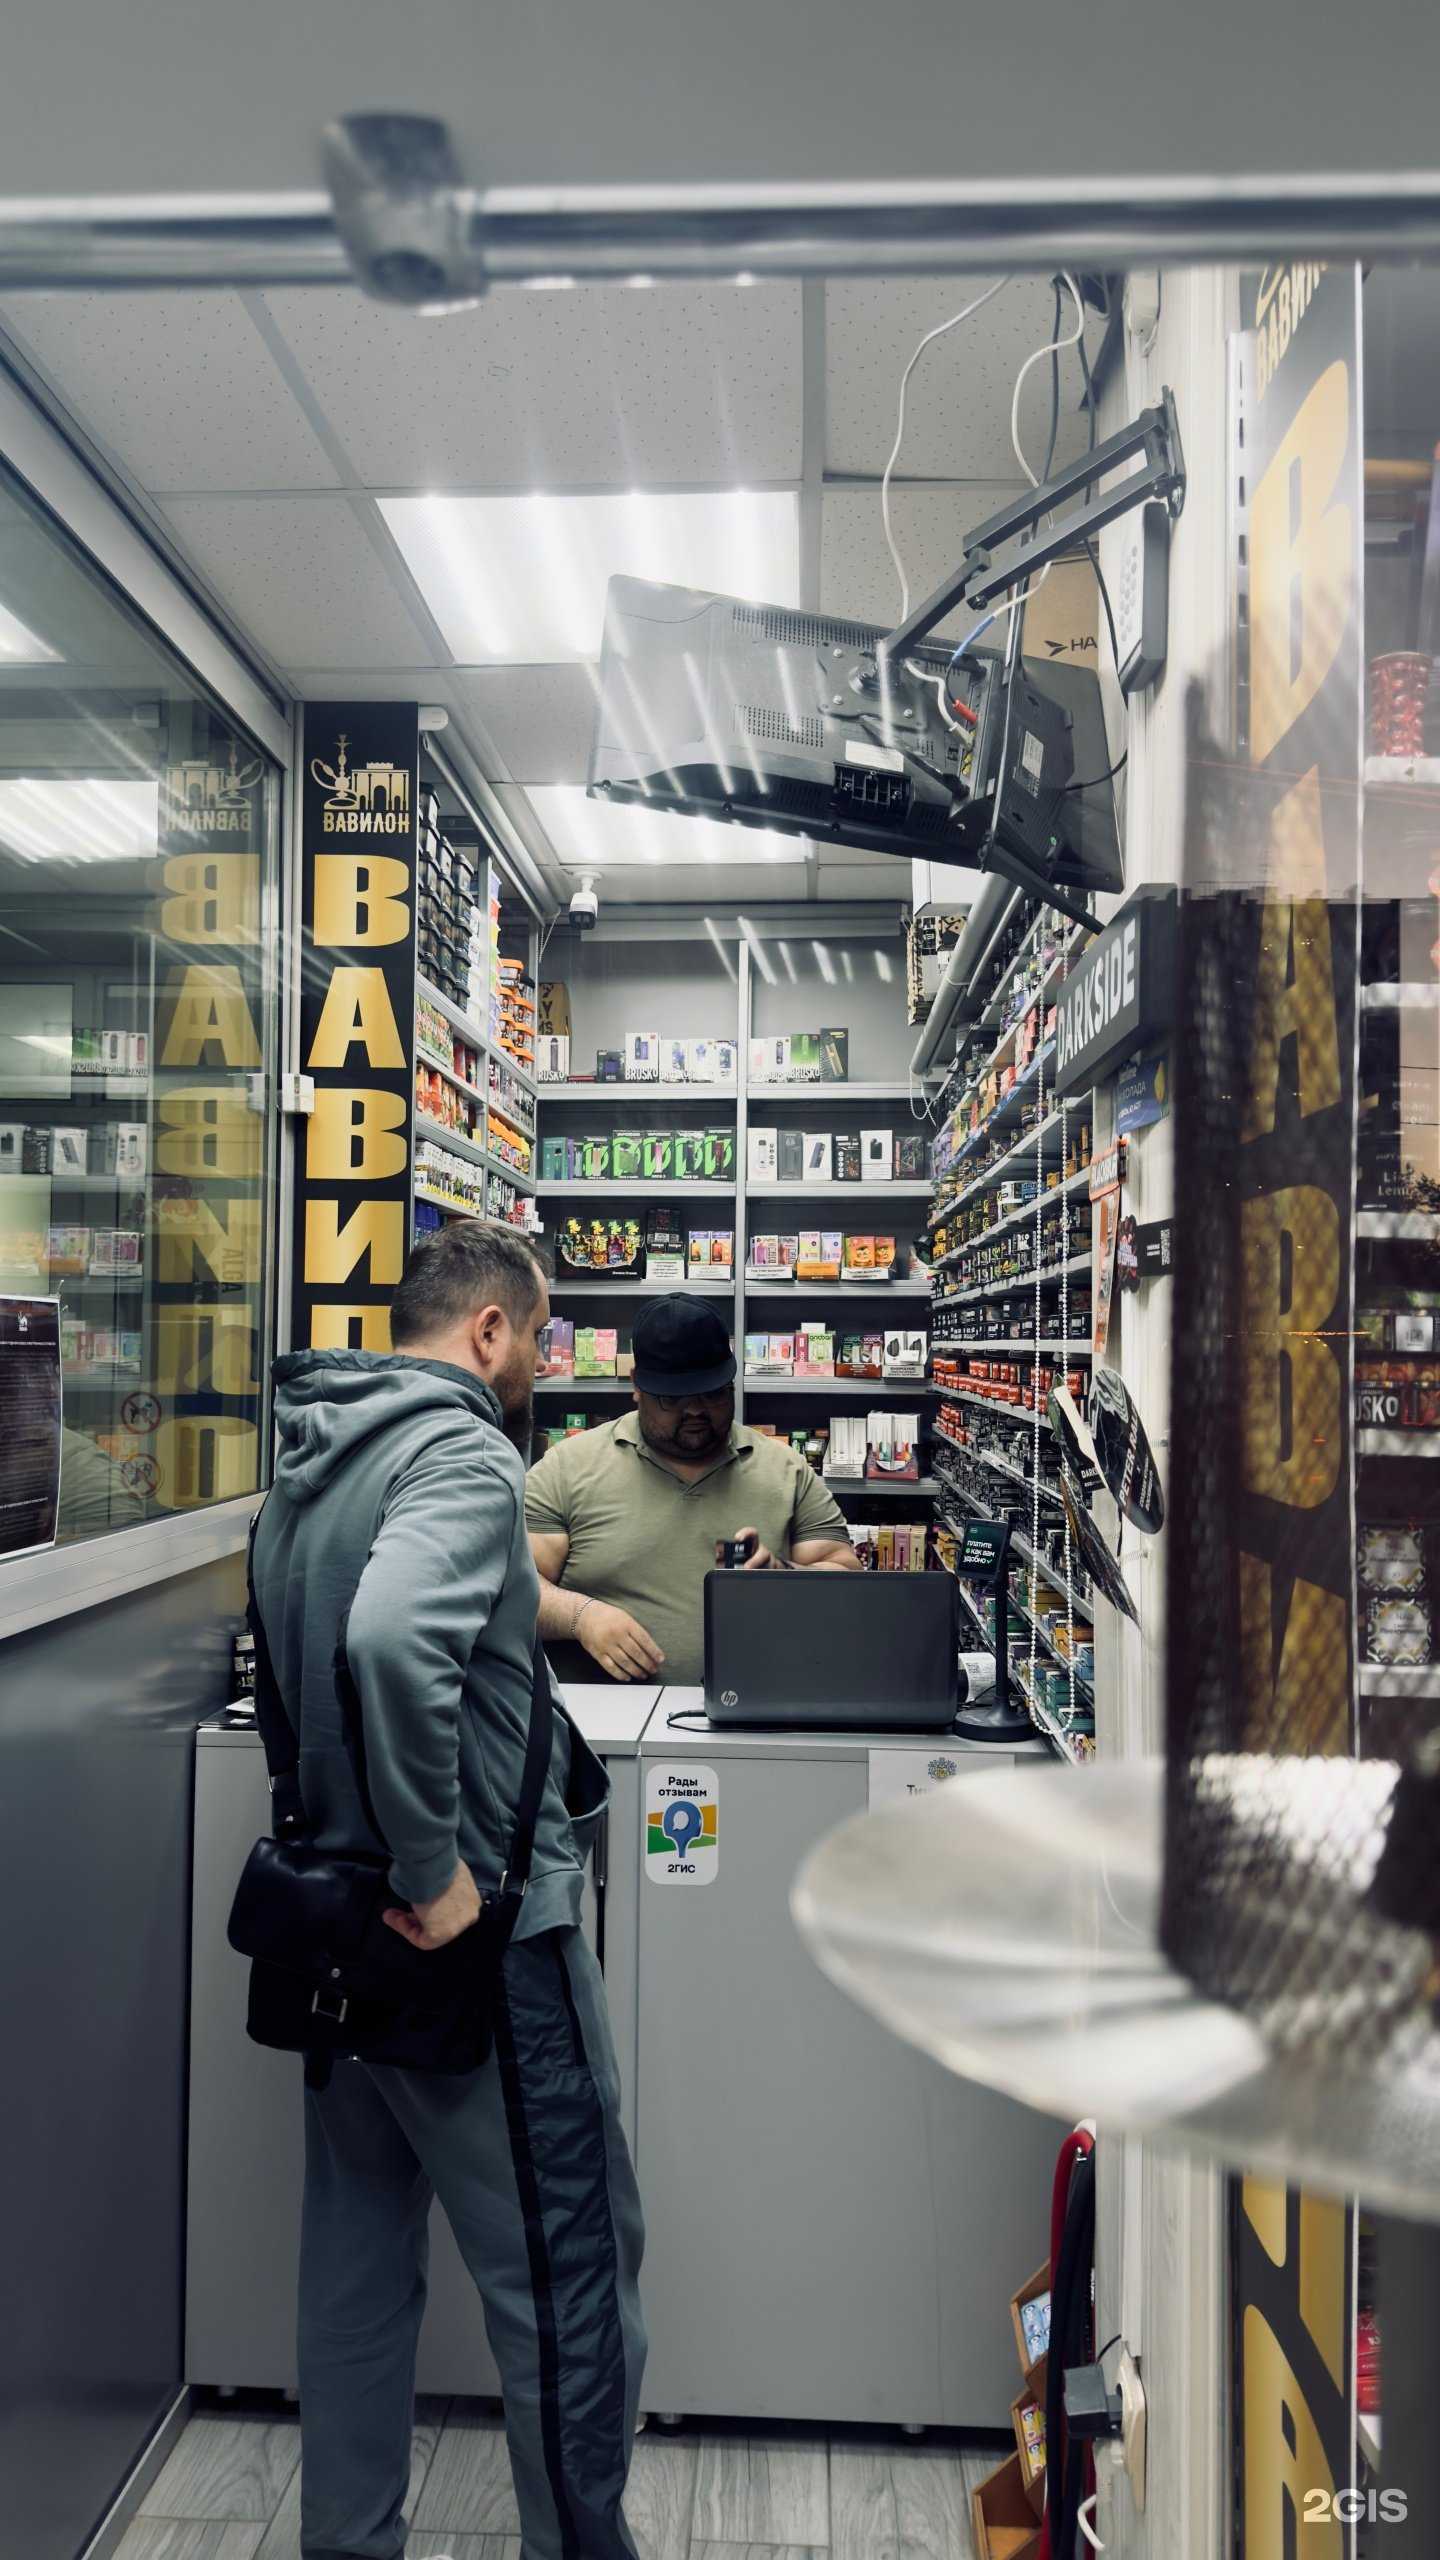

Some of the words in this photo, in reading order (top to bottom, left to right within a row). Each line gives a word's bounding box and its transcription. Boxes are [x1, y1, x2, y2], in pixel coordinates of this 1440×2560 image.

[323, 812, 410, 833] ВАВИЛОН
[1056, 918, 1136, 1073] DARKSIDE
[625, 1067, 658, 1081] BRUSKO
[1119, 1449, 1135, 1506] PETER
[721, 1690, 738, 1706] hp
[668, 1776, 698, 1787] Рады
[658, 1789, 707, 1797] отзывам
[667, 1864, 696, 1873] 2ГИС
